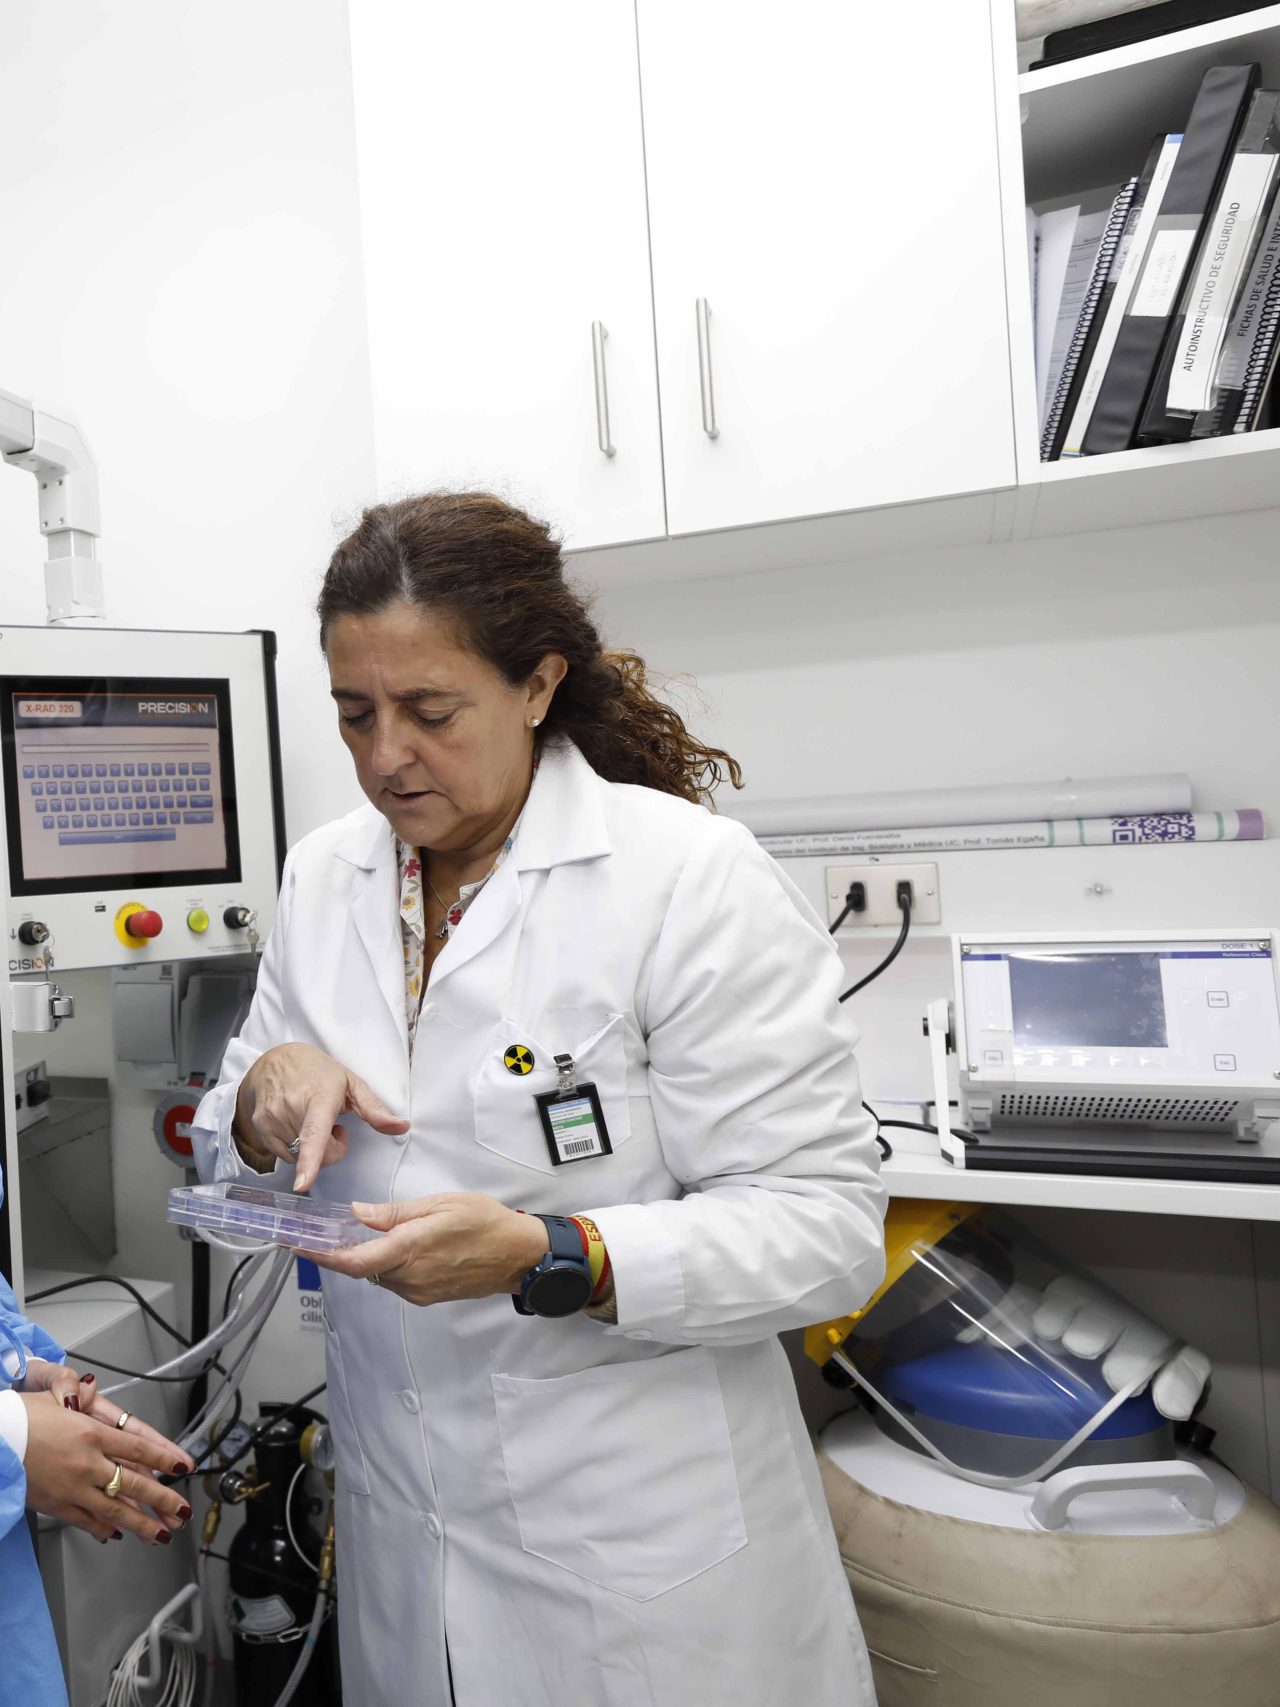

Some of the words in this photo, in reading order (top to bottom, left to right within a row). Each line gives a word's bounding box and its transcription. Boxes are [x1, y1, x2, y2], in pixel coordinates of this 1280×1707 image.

[1215, 202, 1241, 263] SEGURIDAD
[1209, 263, 1222, 279] DE
[1255, 253, 1274, 286] SALUD
[1250, 287, 1263, 301] DE
[1183, 280, 1217, 372] AUTOINSTRUCTIVO
[1237, 301, 1258, 337] FICHAS
[25, 704, 56, 713] X-RAD
[58, 704, 74, 713] 320
[138, 702, 209, 714] PRECISION
